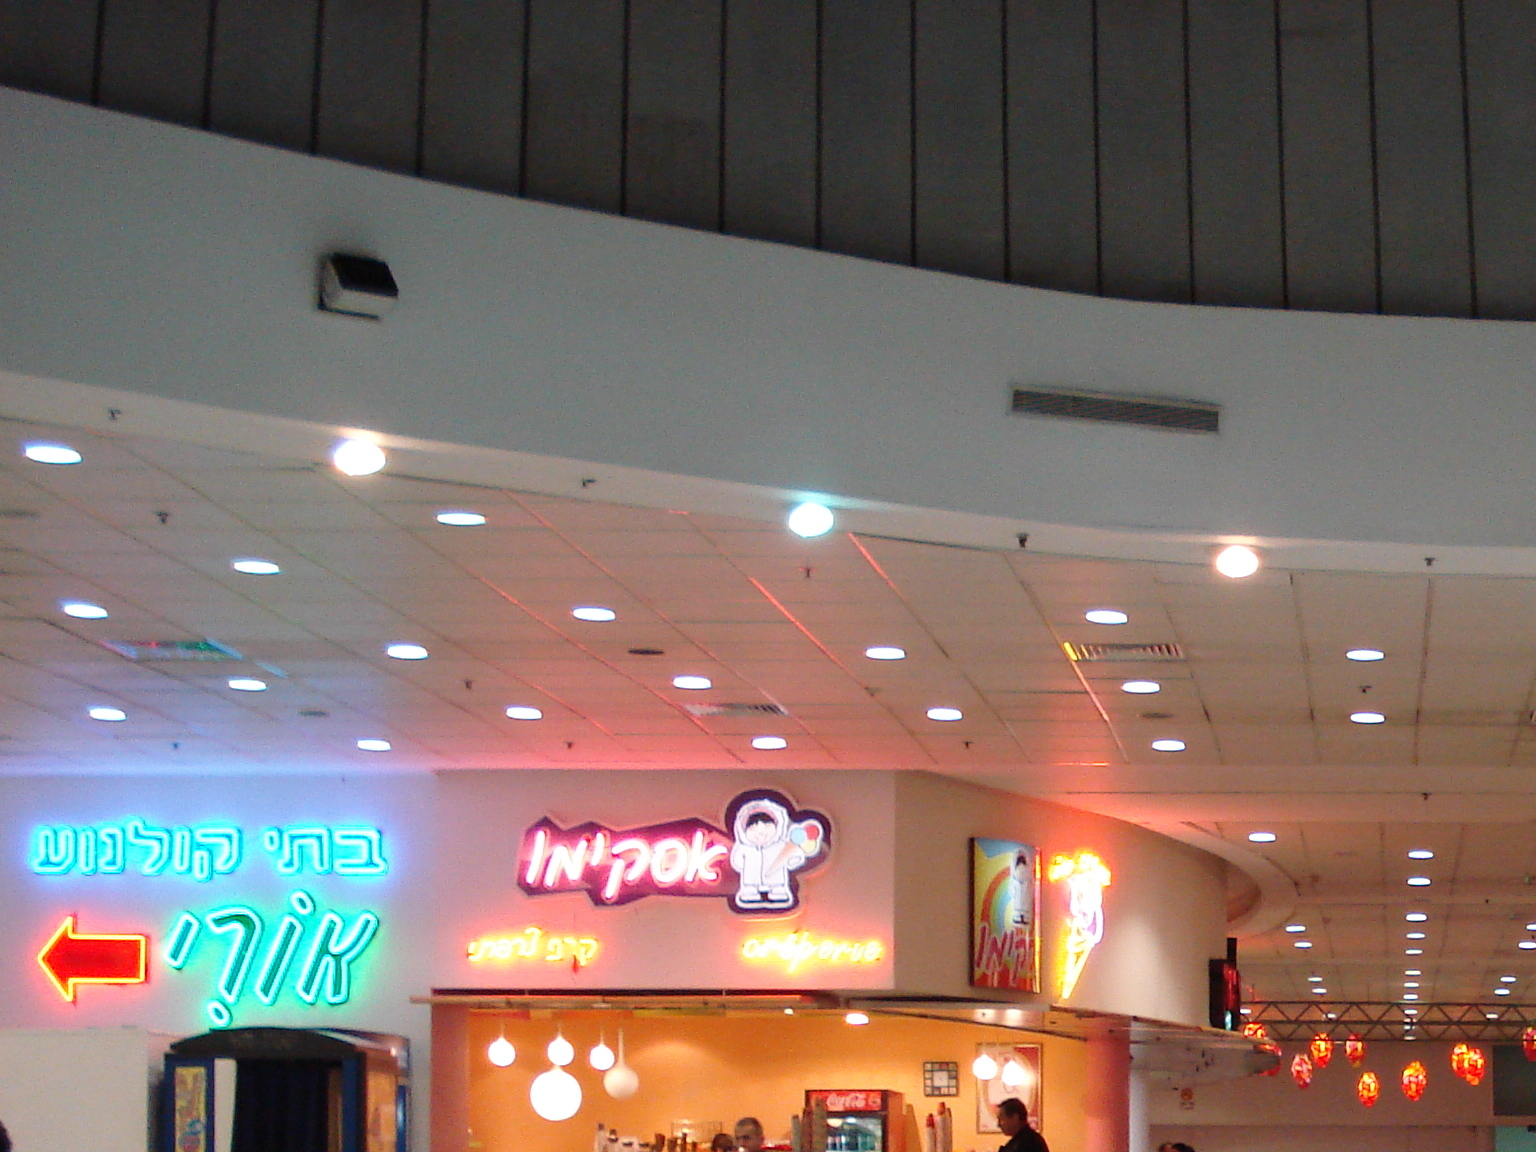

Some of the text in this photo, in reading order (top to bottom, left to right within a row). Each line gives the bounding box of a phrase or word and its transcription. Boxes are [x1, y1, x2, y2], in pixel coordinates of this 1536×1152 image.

[32, 815, 388, 882] בתי קולנוע
[526, 829, 728, 900] אסקימו
